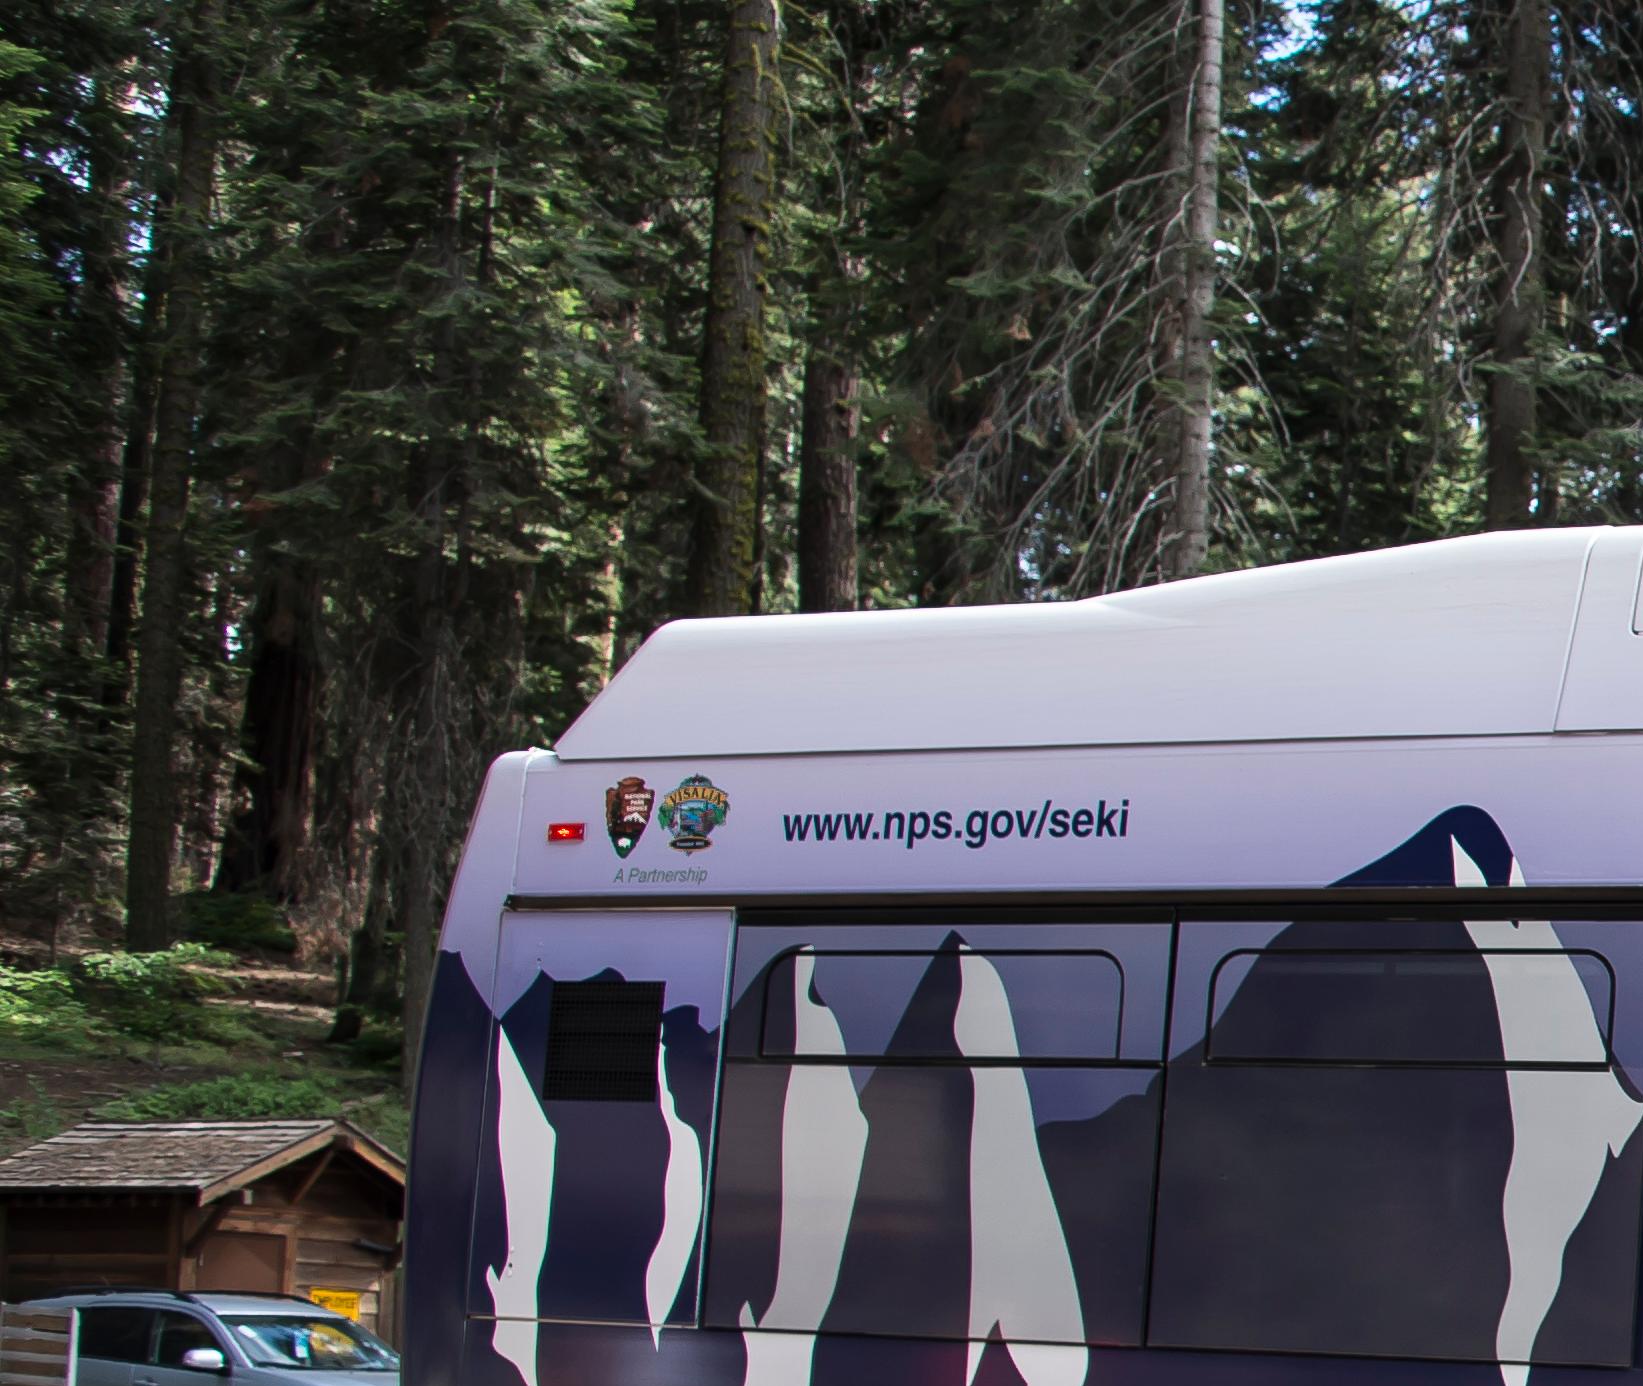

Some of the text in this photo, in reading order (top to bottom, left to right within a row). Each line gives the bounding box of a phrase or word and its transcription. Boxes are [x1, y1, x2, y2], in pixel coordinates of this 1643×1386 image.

[670, 788, 722, 805] VISALIA
[782, 799, 1130, 850] www.nps.gov/seki
[613, 866, 708, 886] A Partnership
